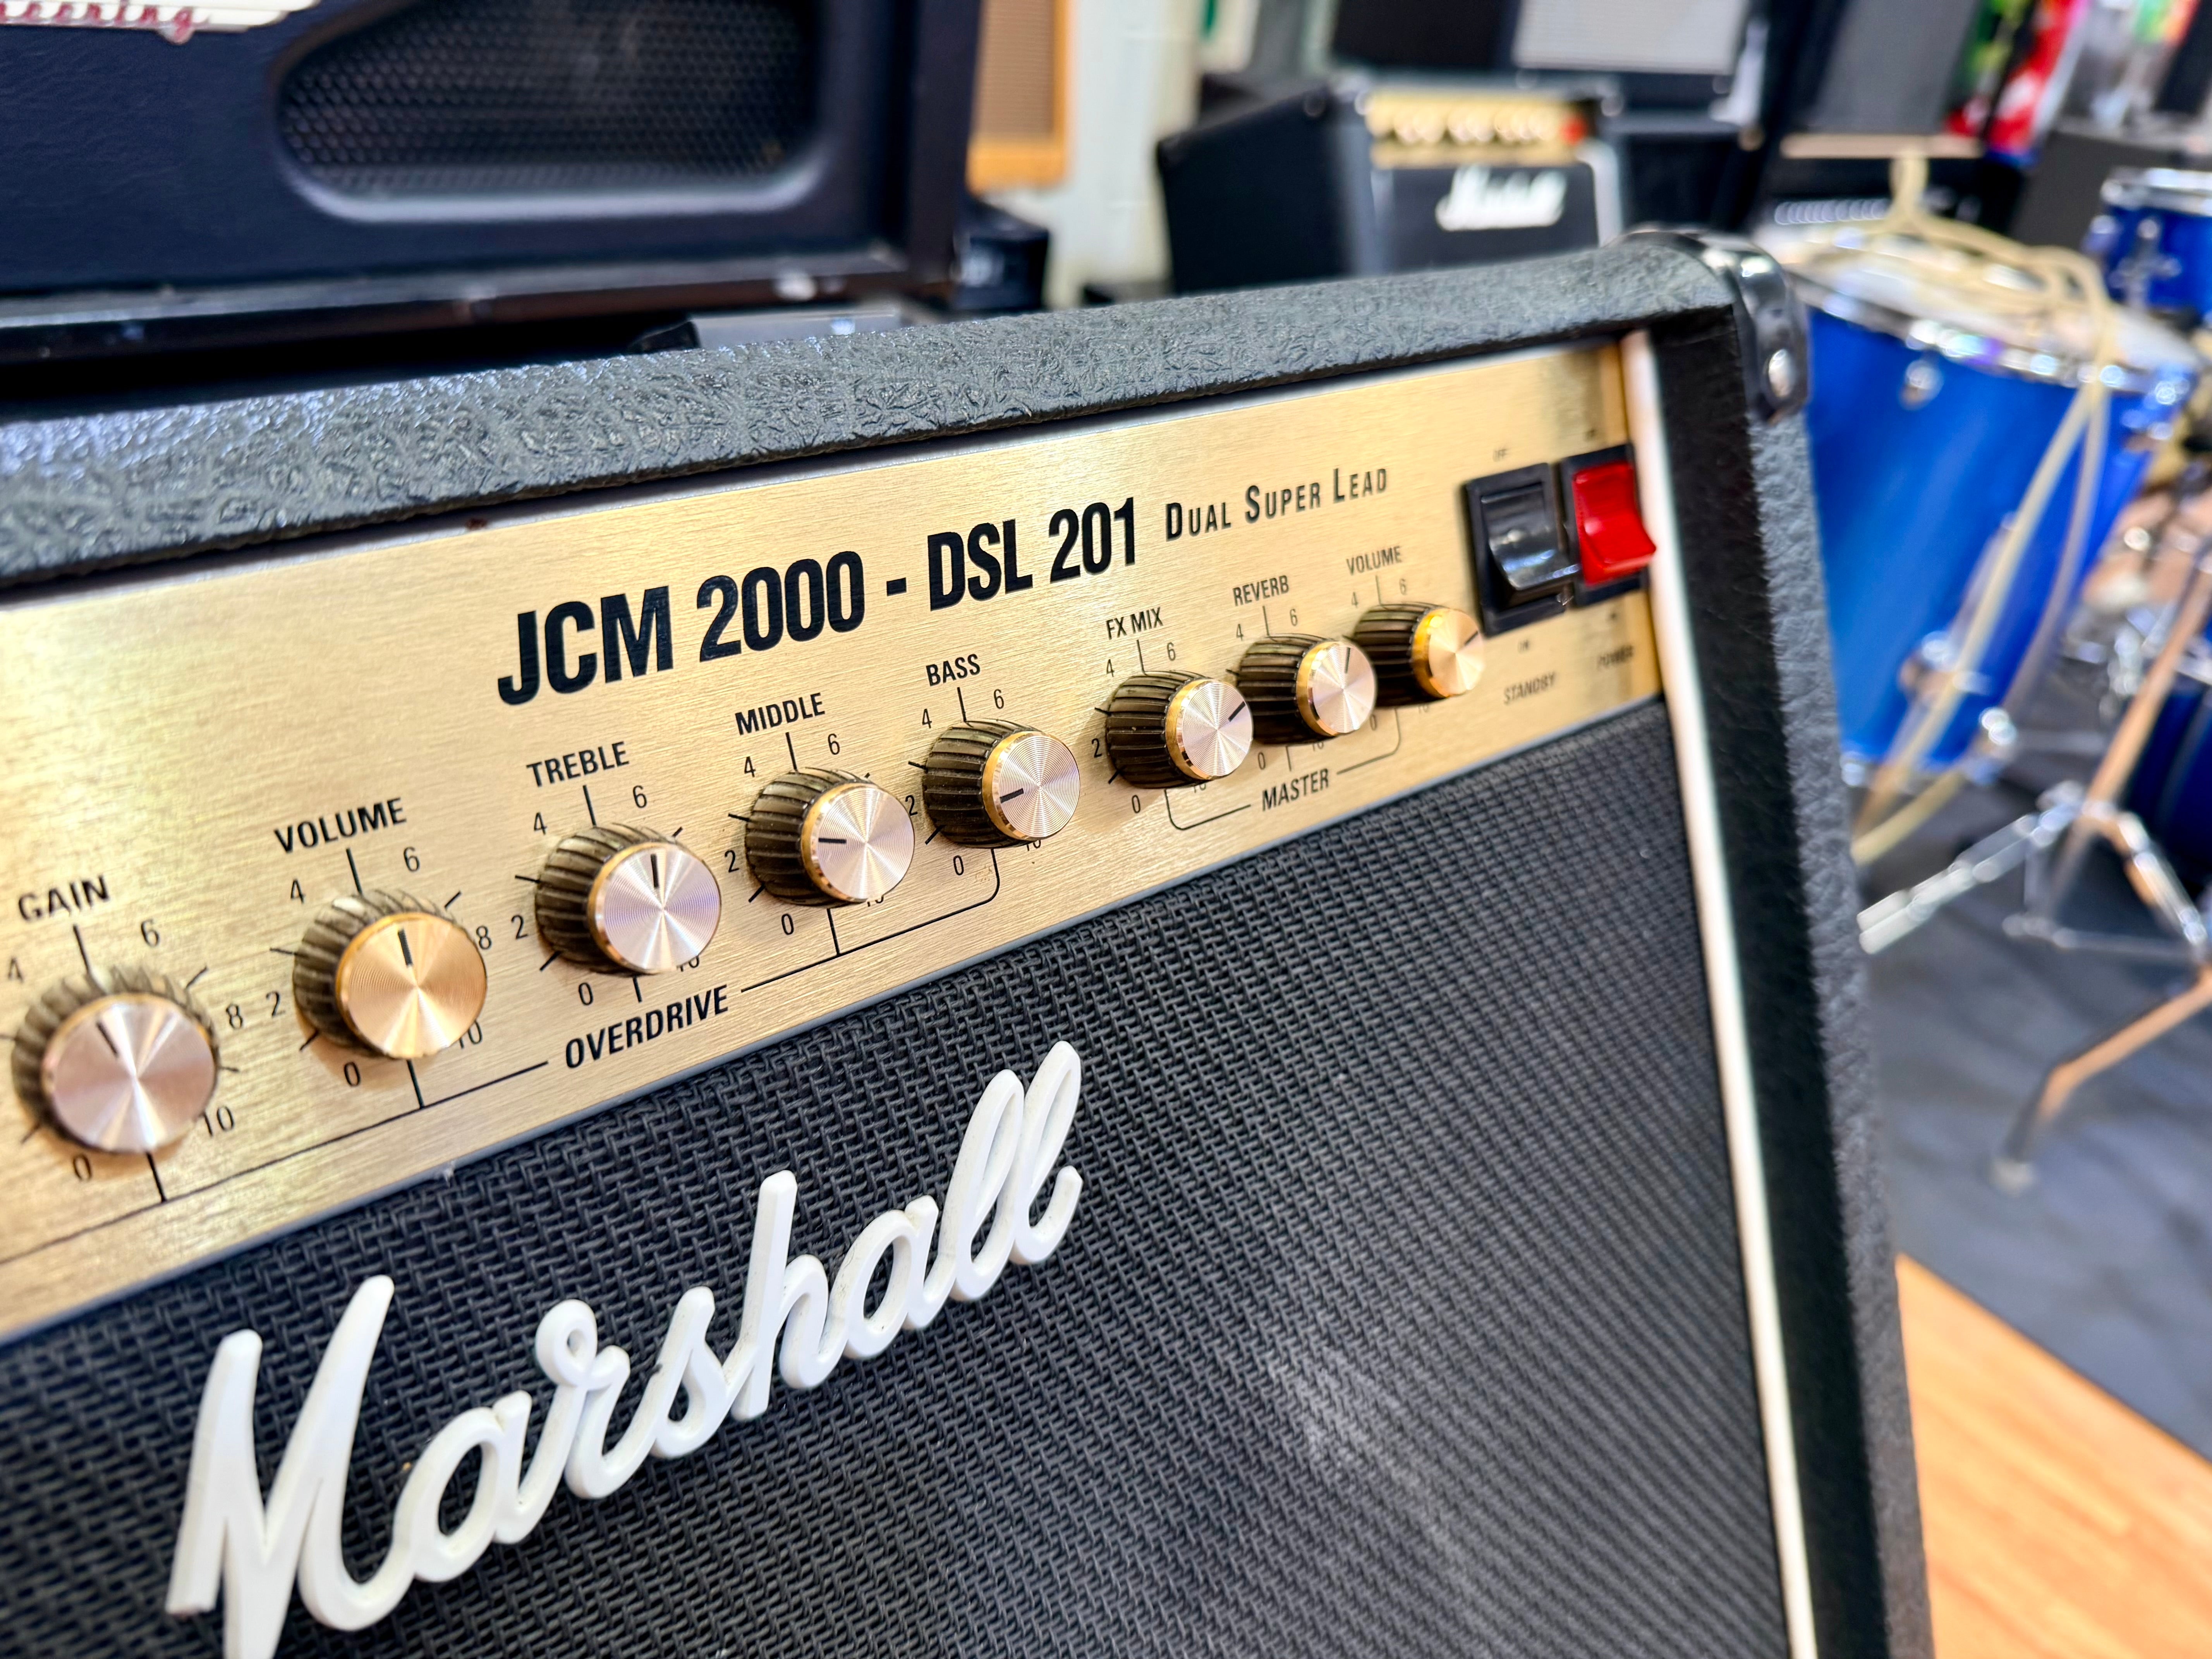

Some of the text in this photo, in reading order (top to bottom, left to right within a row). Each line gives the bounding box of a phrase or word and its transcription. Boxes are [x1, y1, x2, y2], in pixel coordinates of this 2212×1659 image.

[1347, 546, 1402, 575] VOLUME
[1233, 575, 1289, 606] REVERB
[1351, 591, 1358, 607] 4
[1399, 579, 1407, 596] 6
[498, 586, 673, 706] JCM
[697, 551, 865, 663] 2000
[886, 577, 907, 596] -
[927, 519, 1033, 611] DSL
[1048, 496, 1135, 584] 201
[1106, 607, 1163, 640] FX MIX
[1290, 608, 1298, 626] 6
[1236, 623, 1244, 641] 4
[1166, 642, 1176, 661] 6
[926, 653, 981, 686] BASS
[1106, 659, 1115, 677] 4
[994, 689, 1005, 709] 6
[1504, 672, 1556, 704] STANDBY
[735, 693, 825, 735] MIDDLE
[922, 708, 932, 729] 4
[828, 733, 840, 755] 6
[1091, 738, 1103, 758] 2
[527, 741, 630, 787] TREBLE
[744, 756, 756, 778] 4
[1258, 751, 1266, 770] 0
[633, 785, 647, 809] 6
[1262, 768, 1330, 811] MASTER
[905, 795, 918, 816] 2
[1132, 794, 1141, 813] 0
[274, 798, 407, 853] VOLUME
[534, 812, 547, 835] 4
[403, 847, 420, 872] 6
[725, 850, 739, 872] 2
[953, 855, 964, 876] 0
[18, 875, 110, 922] GAIN
[290, 879, 306, 903] 4
[140, 919, 160, 947] 6
[511, 915, 527, 939] 2
[781, 913, 794, 935] 0
[476, 926, 492, 950] 8
[8, 958, 23, 983] 4
[266, 991, 285, 1017] 2
[578, 982, 594, 1006] 0
[225, 1004, 244, 1030] 8
[565, 984, 728, 1069] OVERDRIVE
[344, 1061, 361, 1087] 0
[202, 1106, 235, 1137] 10
[73, 1154, 92, 1182] 0
[165, 1040, 1082, 1659] Marshall
